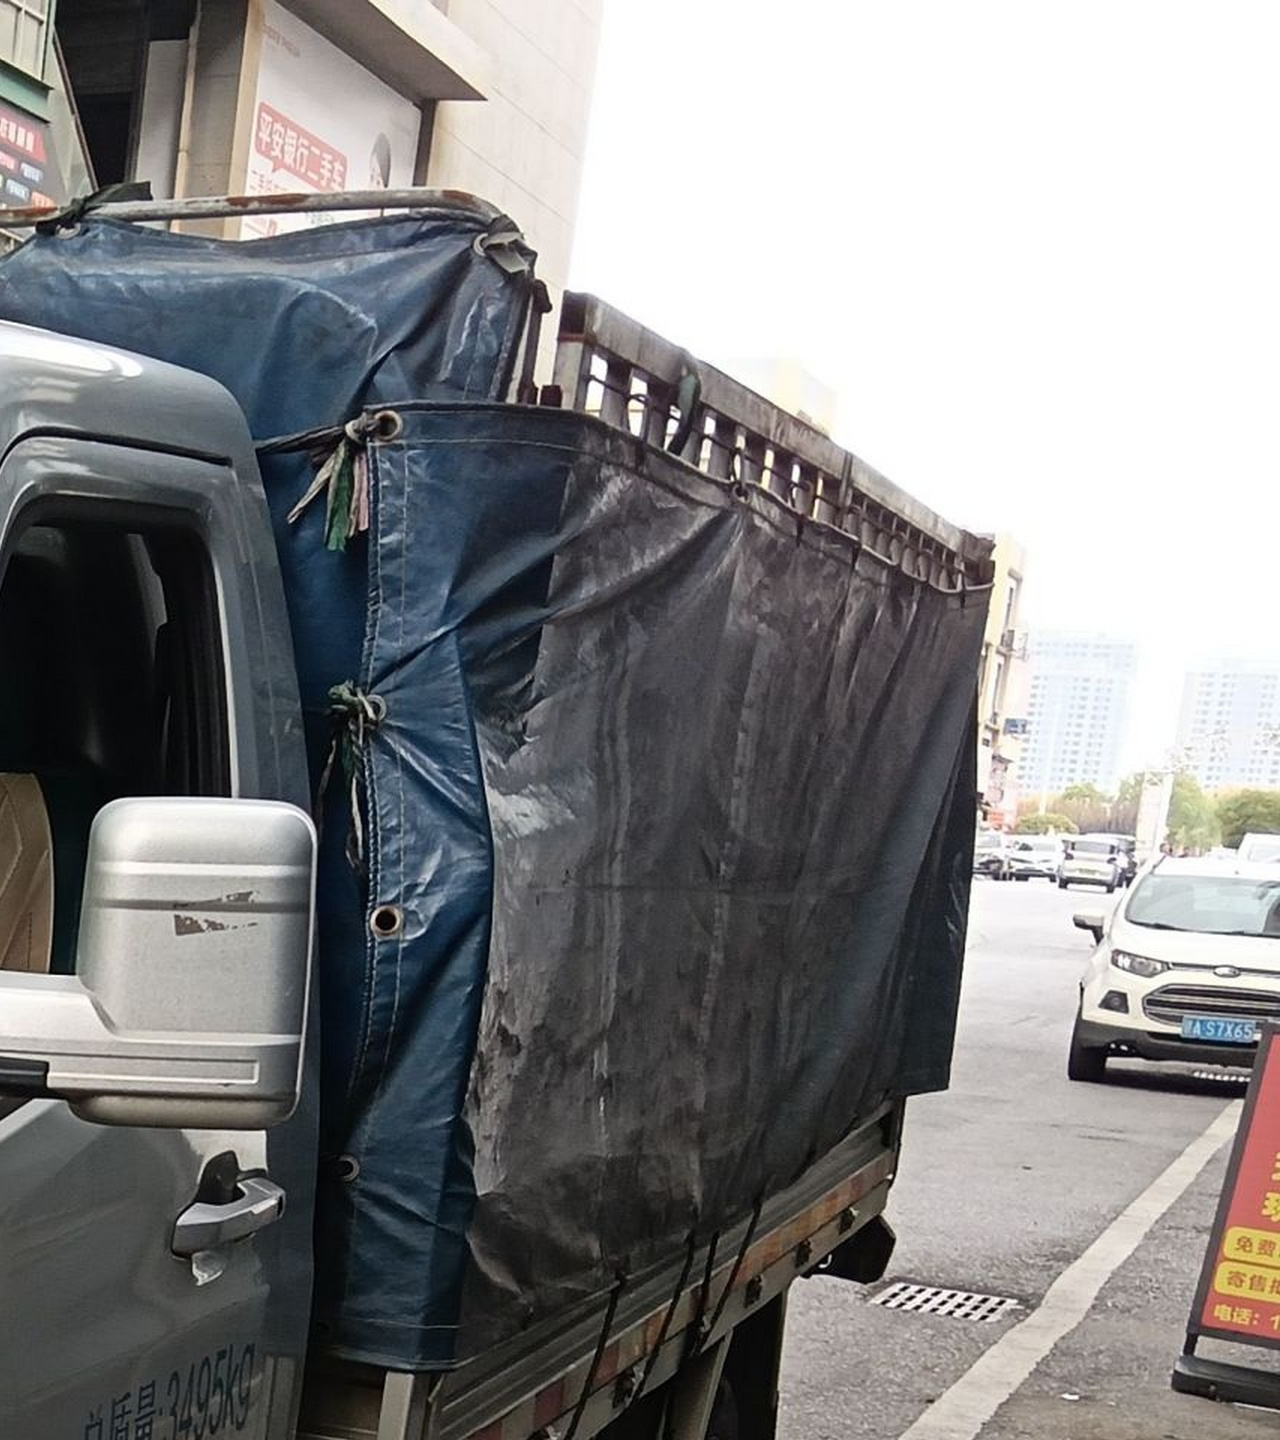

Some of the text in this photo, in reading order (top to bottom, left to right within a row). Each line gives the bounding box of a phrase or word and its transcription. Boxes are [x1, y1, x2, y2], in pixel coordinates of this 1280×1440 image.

[259, 112, 345, 191] 平安银行二手车
[1235, 1235, 1280, 1258] 免费
